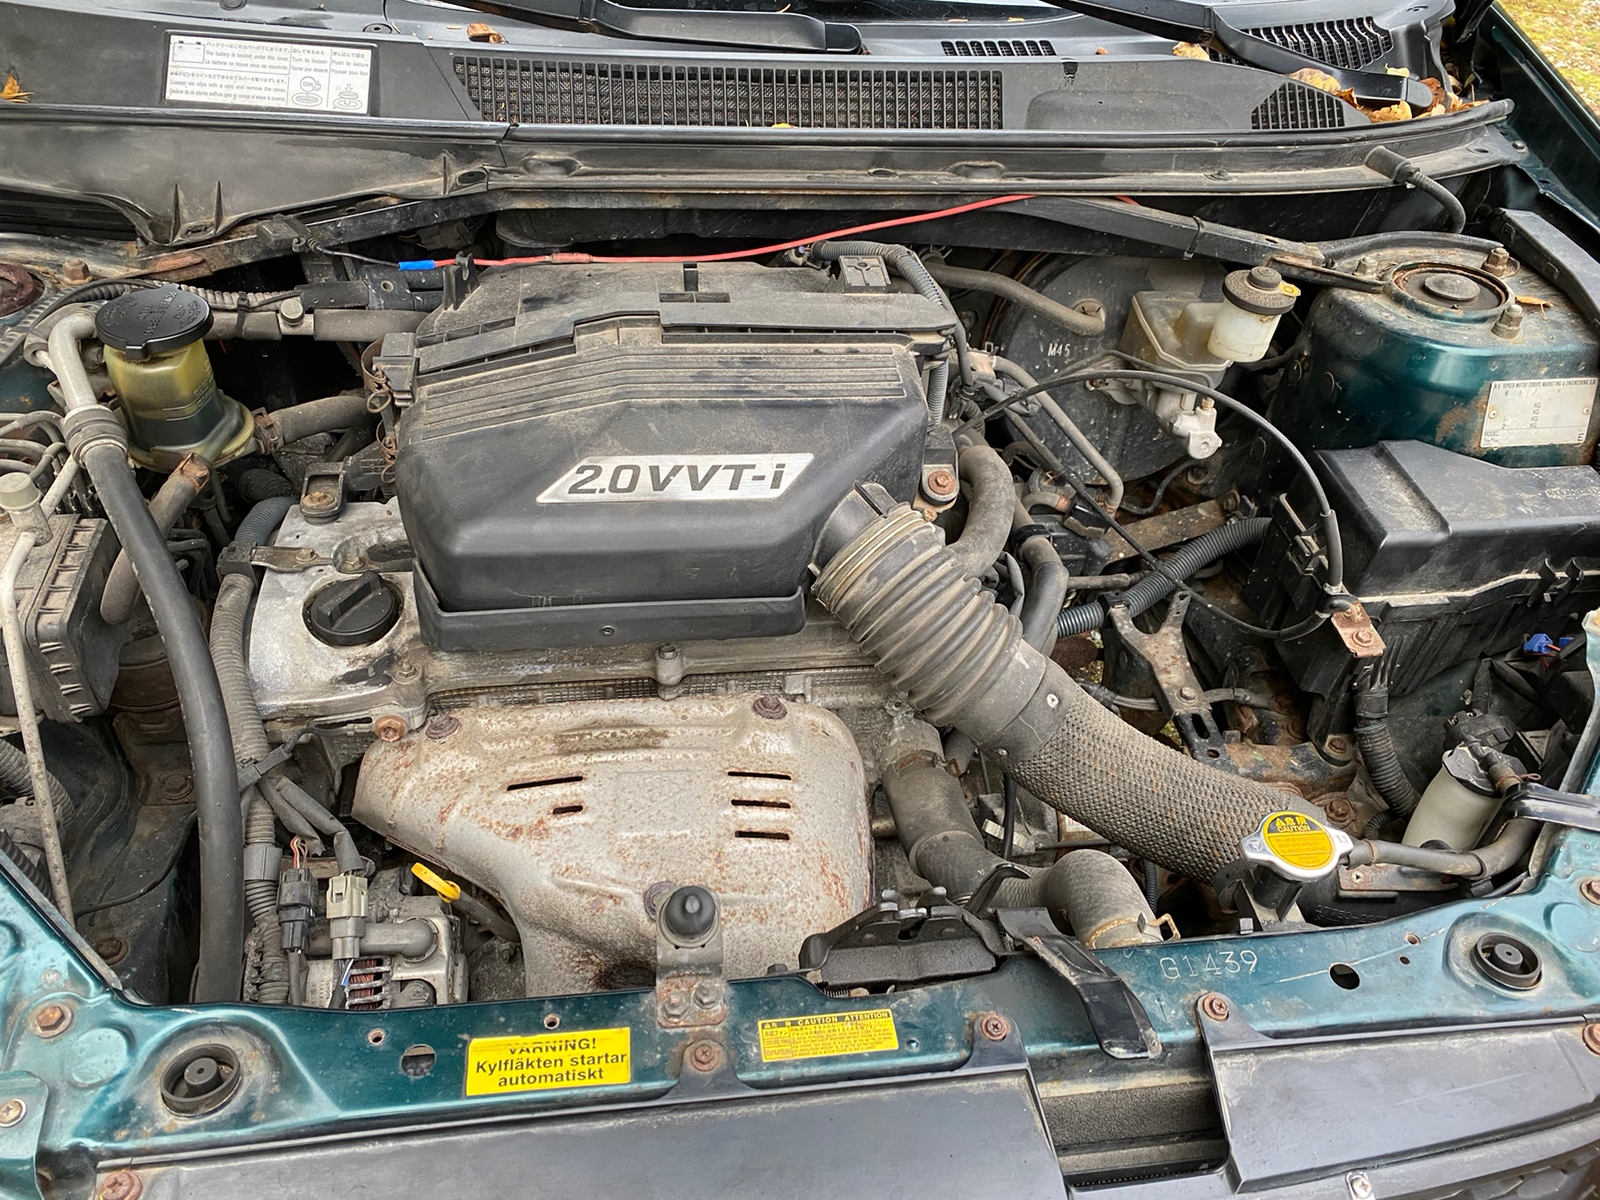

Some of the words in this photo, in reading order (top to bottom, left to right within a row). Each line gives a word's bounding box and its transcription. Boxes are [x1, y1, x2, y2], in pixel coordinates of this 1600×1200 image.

[215, 50, 230, 58] battery
[1048, 343, 1070, 357] M45
[1577, 433, 1584, 441] E
[567, 464, 642, 495] 2.0
[649, 463, 786, 492] VVT-i
[1277, 824, 1311, 833] CAUTION
[1160, 950, 1258, 979] G1439
[797, 1015, 838, 1026] CAUTION
[845, 1012, 888, 1022] ATTENTION
[509, 1038, 596, 1055] VARNING!
[476, 1056, 563, 1076] Kylfläkten
[570, 1052, 627, 1067] startar
[498, 1068, 604, 1087] automatiskt
